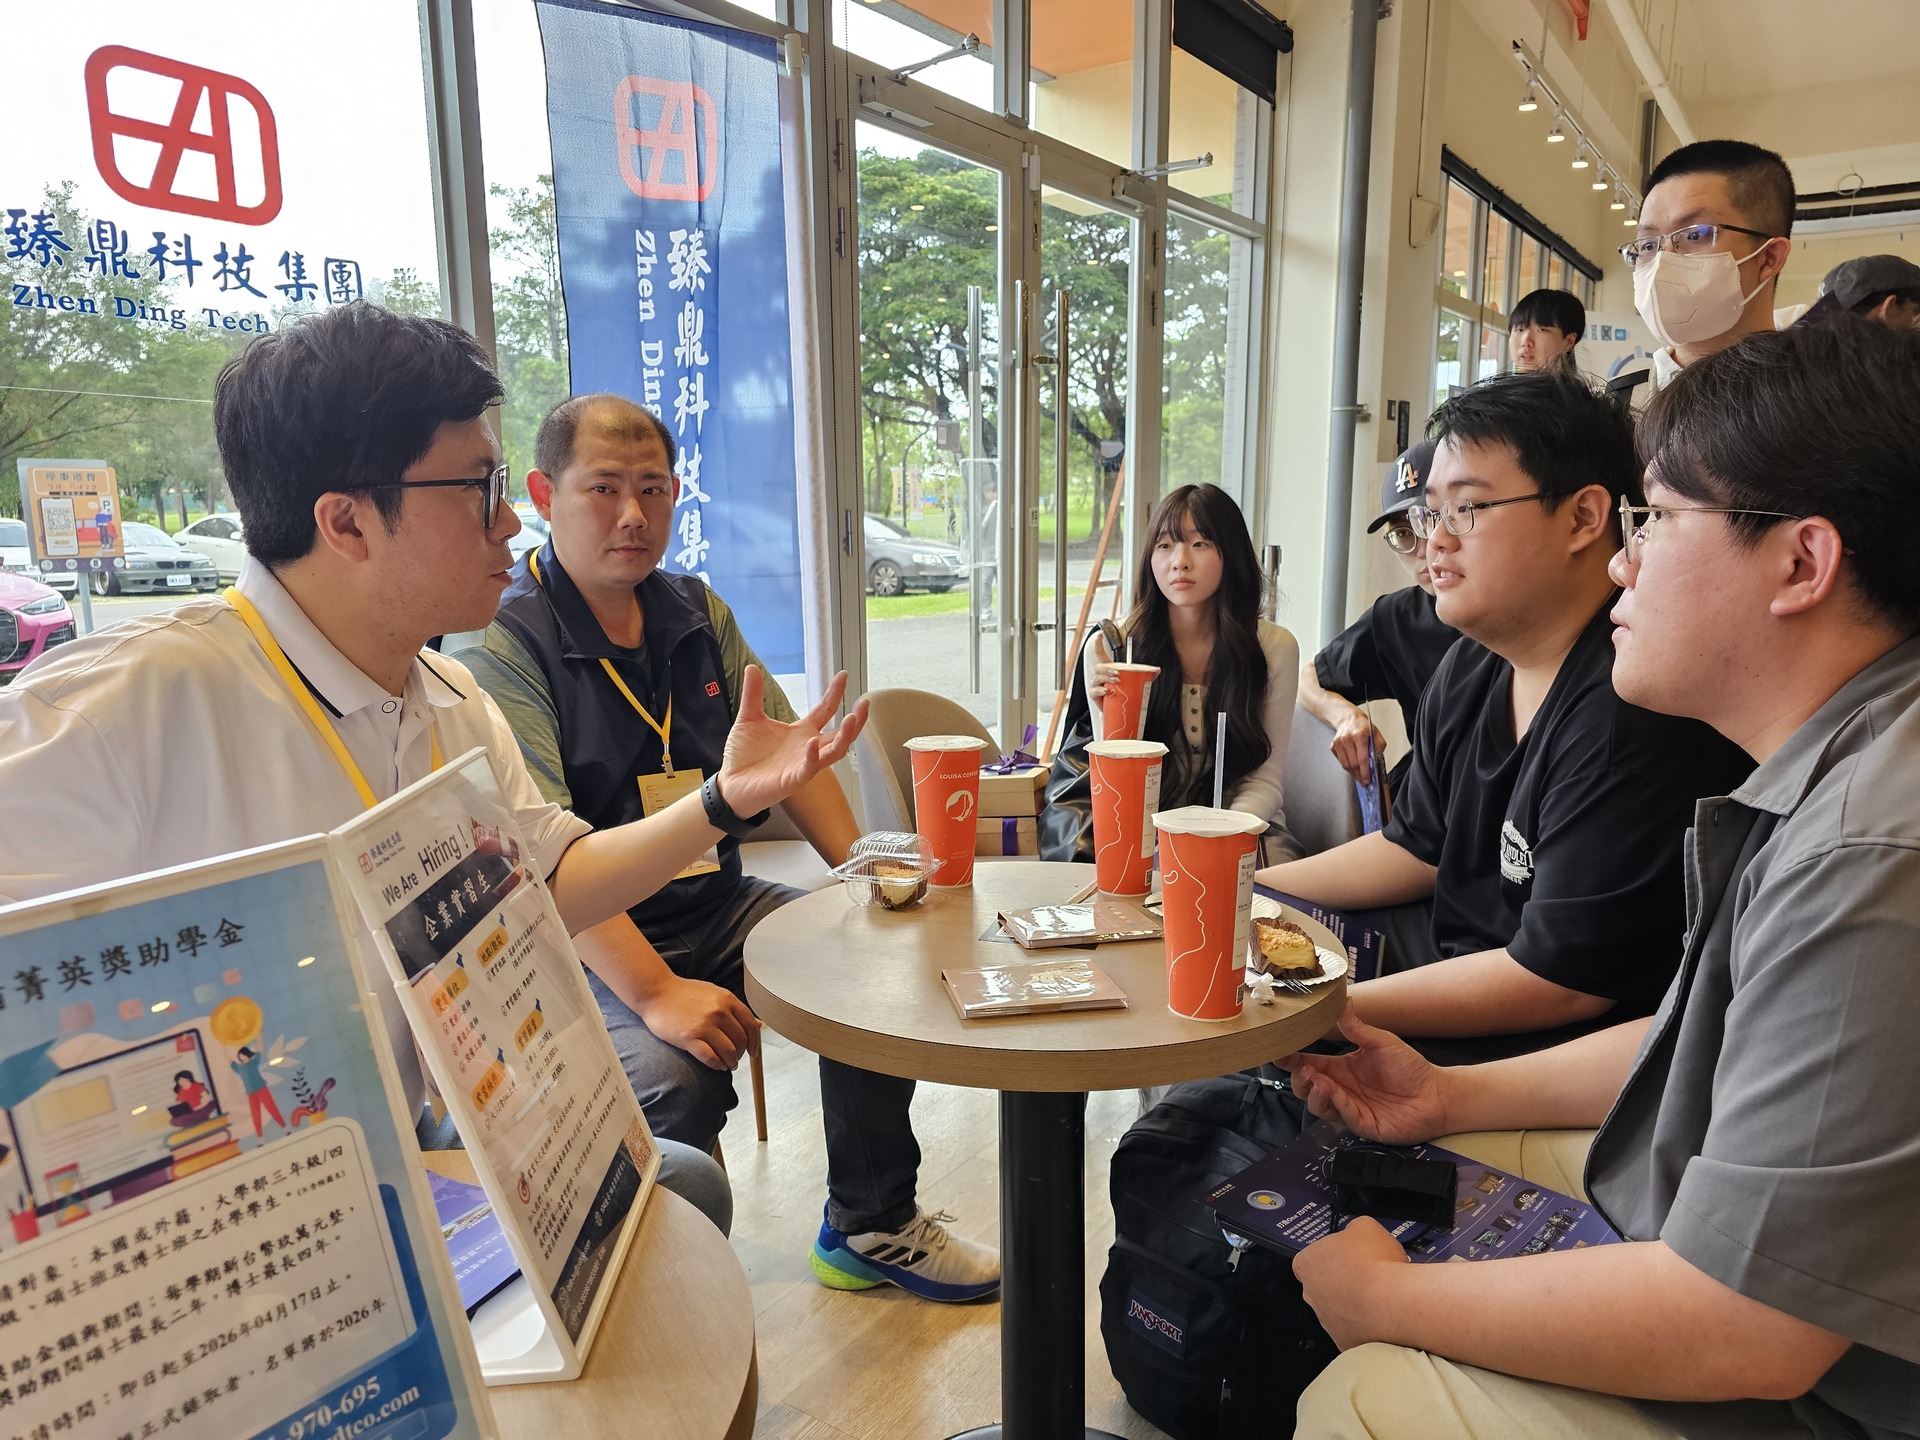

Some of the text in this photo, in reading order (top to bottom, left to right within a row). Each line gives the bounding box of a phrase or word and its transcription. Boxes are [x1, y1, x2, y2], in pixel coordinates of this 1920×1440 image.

[5, 208, 363, 305] 臻鼎科技集團
[635, 229, 657, 323] Zhen
[11, 284, 270, 334] Zhen Ding Tech
[667, 228, 712, 588] 臻鼎科技集
[1395, 457, 1419, 493] LA
[382, 885, 402, 906] We
[401, 873, 419, 894] Are
[418, 834, 462, 876] Hiring
[424, 870, 490, 941] 企業實習生
[0, 916, 245, 1011] 菁英獎助學金
[1519, 1193, 1530, 1203] 6G
[11, 1273, 352, 1440] 請時間：即日起至2026年04月17日止。
[1128, 1299, 1182, 1343] JANSPORT
[328, 1386, 420, 1440] dtco.com
